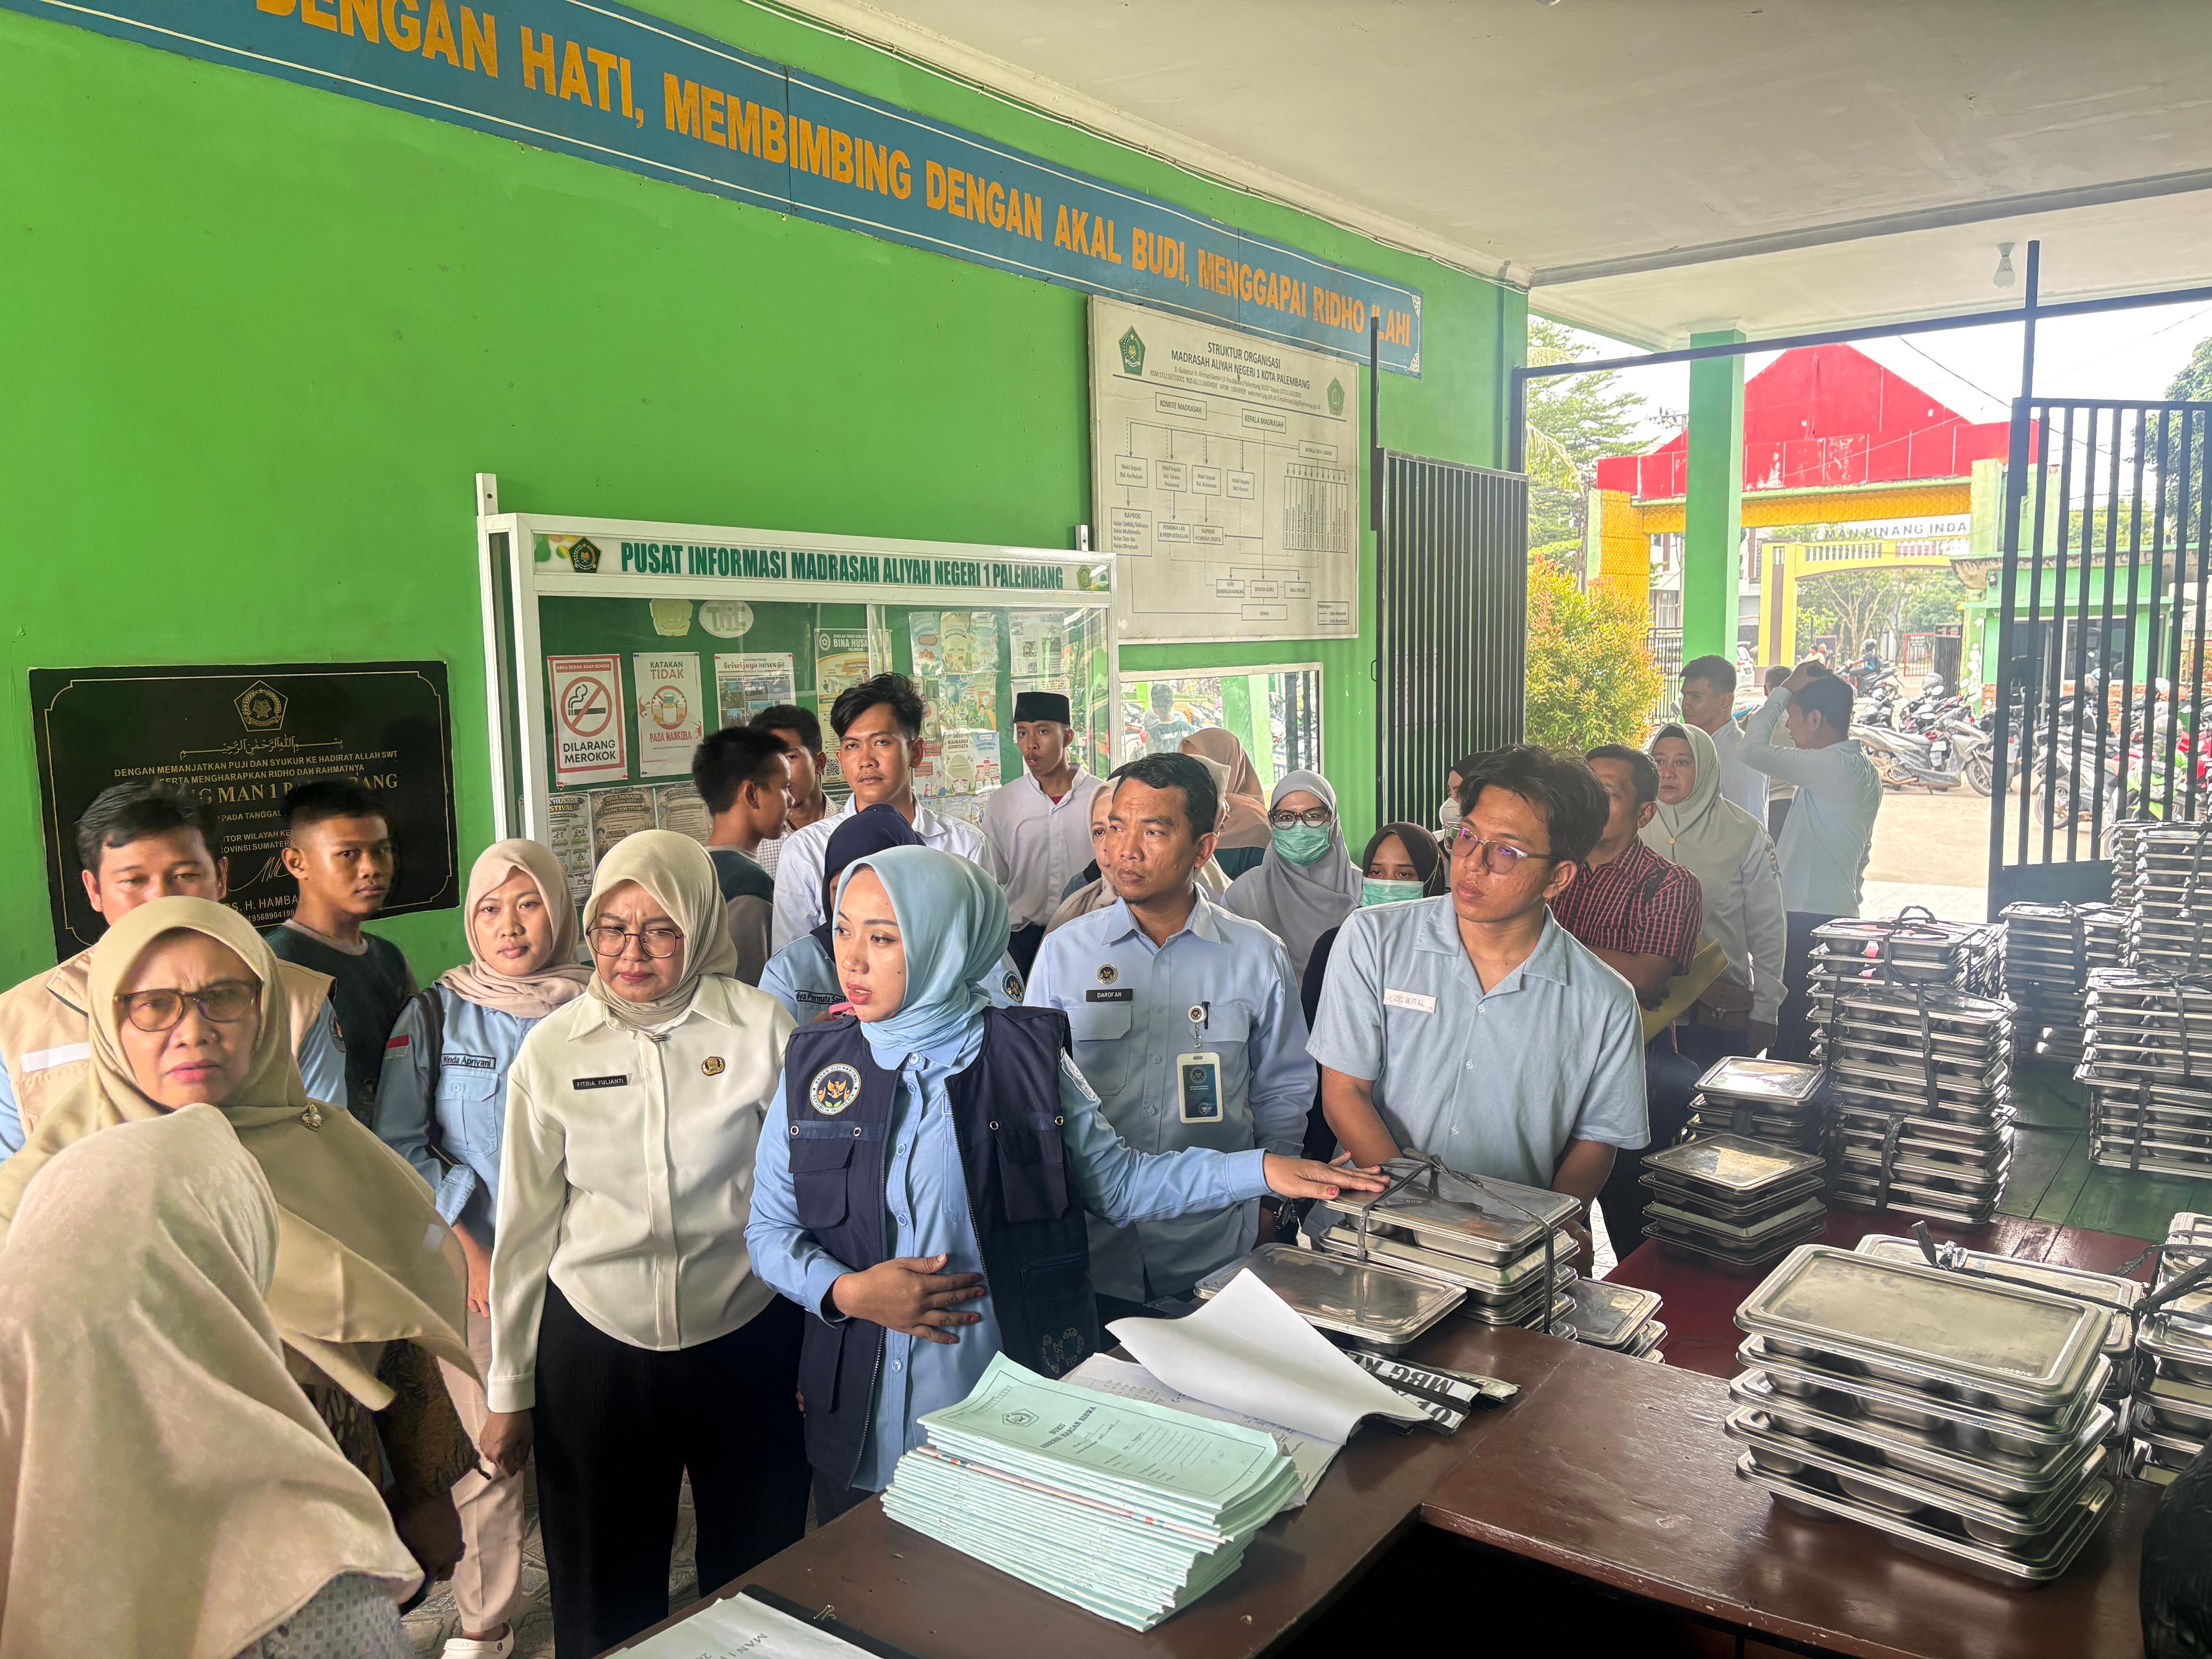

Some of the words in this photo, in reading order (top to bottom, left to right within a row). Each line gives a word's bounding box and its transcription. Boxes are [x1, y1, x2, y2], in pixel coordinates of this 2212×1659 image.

[257, 0, 498, 77] NGAN
[521, 26, 644, 128] HATI,
[664, 73, 911, 199] MEMBIMBING
[927, 161, 1042, 240] DENGAN
[1055, 206, 1121, 264] AKAL
[1133, 228, 1190, 288] BUDI,
[1199, 249, 1306, 317] MENGGAPAI
[1313, 286, 1364, 333] RIDHO
[1208, 342, 1243, 361] STRUKTUR
[1244, 350, 1280, 369] ORGANISASI
[1171, 350, 1210, 367] MADRASAH
[1211, 359, 1233, 372] ALIYAH
[1234, 364, 1255, 378] NEGERI
[1257, 369, 1260, 378] 1
[1261, 370, 1276, 382] KOTA
[1277, 373, 1310, 389] PALEMBANG
[1160, 400, 1177, 410] KOMITE
[1177, 403, 1202, 414] MADRASAH
[1245, 415, 1260, 423] KEPALA
[1261, 417, 1284, 428] MADRASAH
[1865, 524, 1924, 539] PINANG
[1930, 522, 1967, 533] INDA
[622, 542, 683, 574] PUSAT
[688, 547, 786, 579] INFORMASI
[792, 552, 879, 583] MADRASAH
[884, 559, 931, 584] ALIYAH
[935, 560, 981, 586] NEGERI
[983, 563, 990, 586] 1
[993, 564, 1063, 590] PALEMBANG
[650, 668, 684, 680] TIDAK
[650, 733, 665, 742] PADA
[666, 731, 692, 741] NARKOBA
[563, 740, 616, 752] DILARANG
[114, 766, 155, 777] DENGAN
[157, 761, 227, 774] MEMANJATKAN
[229, 760, 248, 769] PUJI
[250, 759, 268, 767] DAN
[270, 756, 304, 766] SYUKUR
[319, 752, 353, 763] HADIRAT
[355, 751, 380, 760] ALLAH
[565, 751, 616, 764] MEROKOK
[191, 770, 266, 784] MENGHARAPKAN
[269, 769, 295, 777] RIDHO
[297, 767, 315, 776] DAN
[315, 764, 364, 774] RAHMATNYA
[217, 784, 264, 803] MAN
[270, 783, 276, 799] 1
[245, 810, 282, 819] TANGGAL
[244, 831, 279, 840] WILAYAH
[245, 900, 256, 910] H.
[815, 1070, 829, 1084] BADAN
[842, 1066, 858, 1083] NASIONAL
[812, 1094, 830, 1112] REPUBLIK
[735, 1632, 769, 1654] MAN
